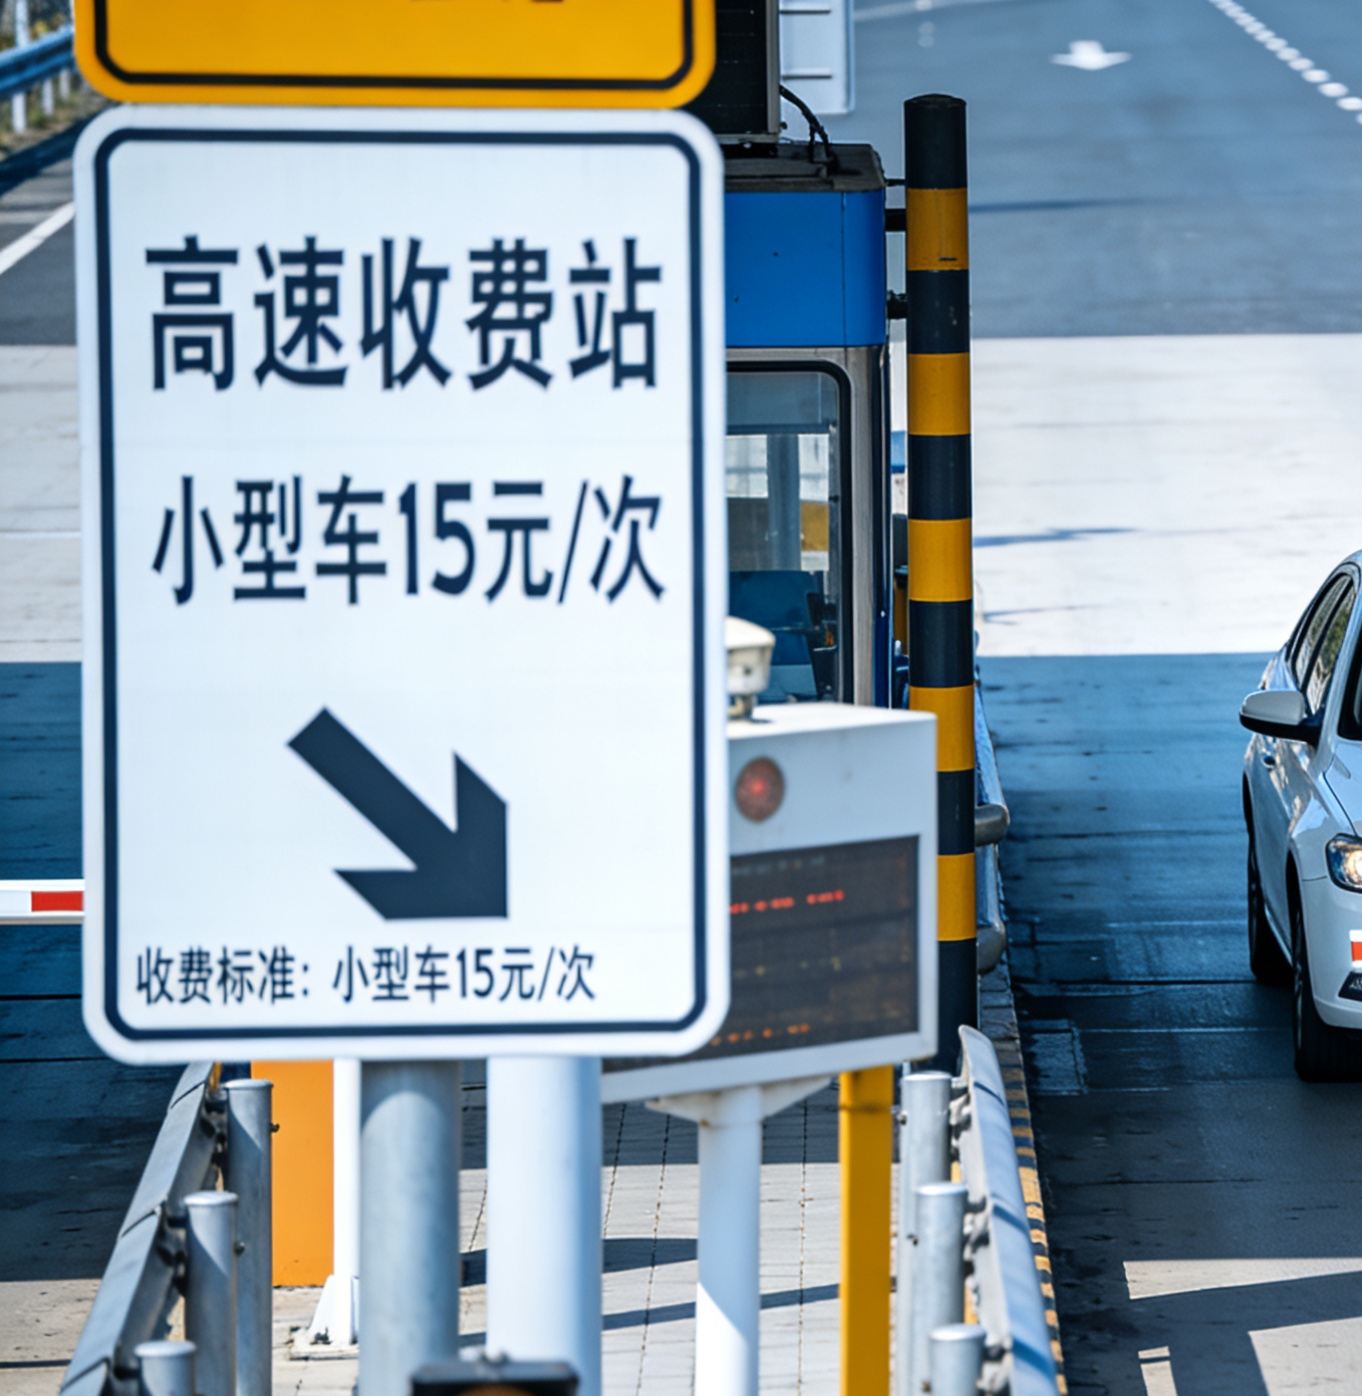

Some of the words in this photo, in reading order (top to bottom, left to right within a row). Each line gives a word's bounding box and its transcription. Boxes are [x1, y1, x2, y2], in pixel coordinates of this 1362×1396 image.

[144, 234, 663, 392] 高速收费站
[151, 474, 665, 606] 小型车15元/次
